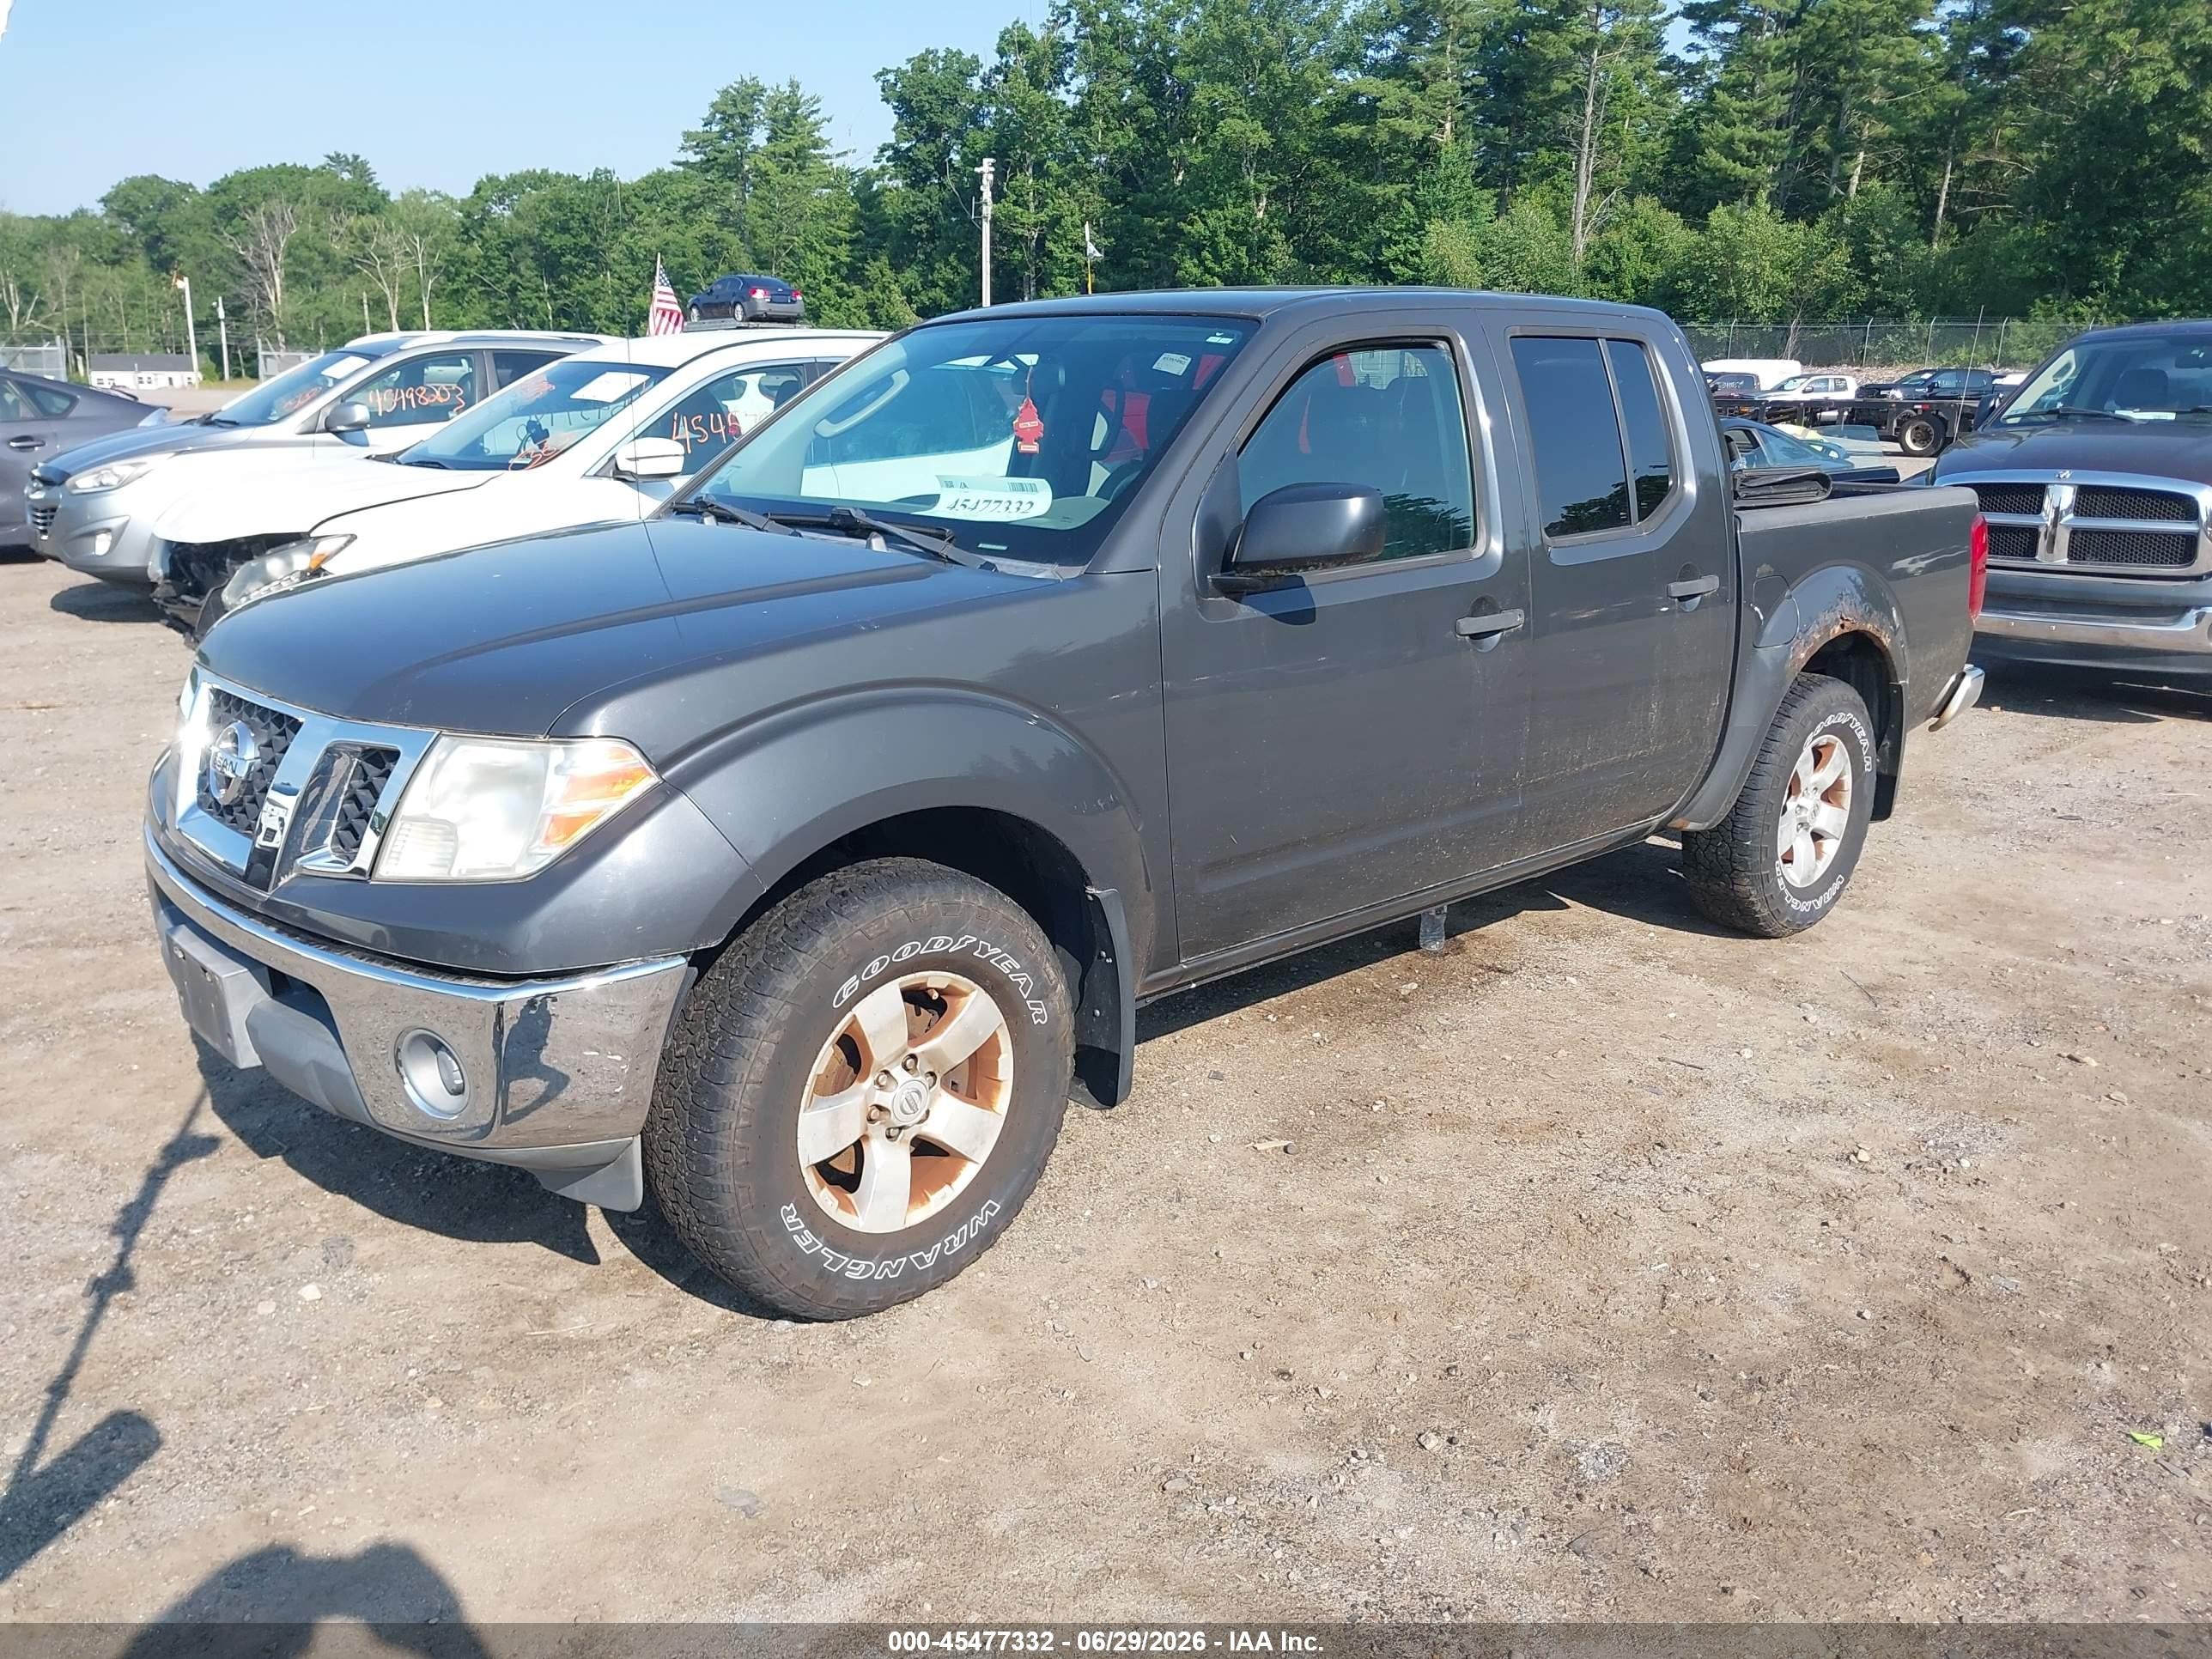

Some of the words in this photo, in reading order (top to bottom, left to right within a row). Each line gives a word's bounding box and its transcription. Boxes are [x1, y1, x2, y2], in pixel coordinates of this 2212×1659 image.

[946, 497, 1035, 514] 45477332
[1802, 712, 1873, 773] GOODYEAR
[832, 934, 1048, 1025] GOODYEAR
[780, 1200, 1001, 1280] WRANGLER
